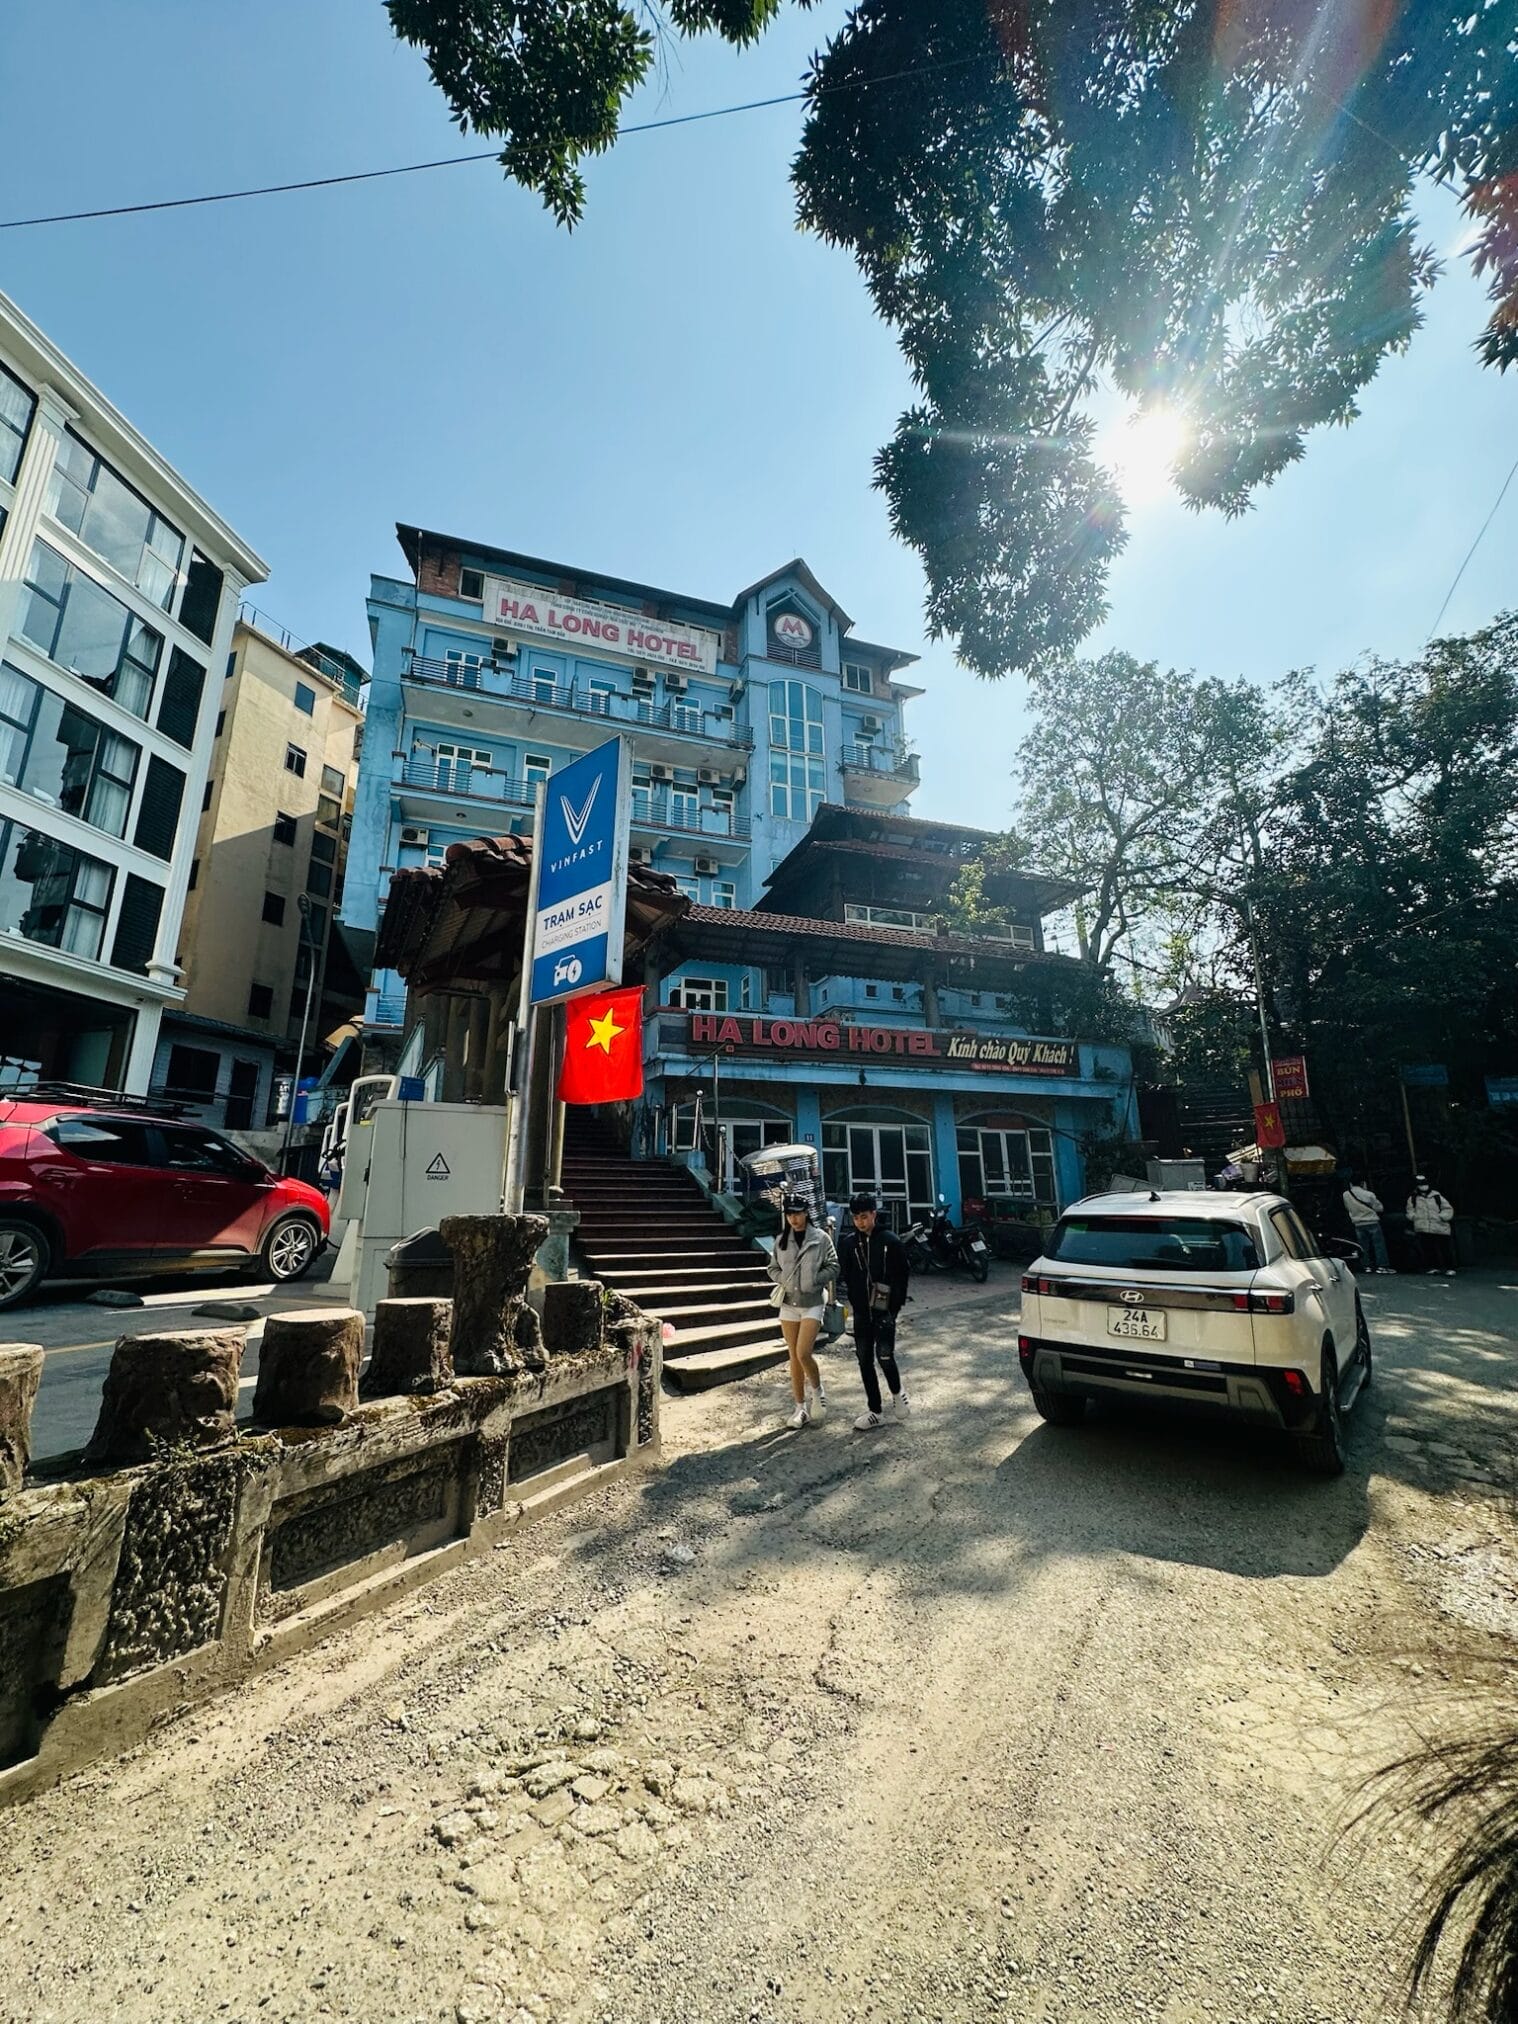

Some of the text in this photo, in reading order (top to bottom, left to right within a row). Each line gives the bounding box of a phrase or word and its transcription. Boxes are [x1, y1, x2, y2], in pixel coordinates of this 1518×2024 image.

[548, 609, 620, 641] LONG
[627, 628, 702, 662] HOTEL
[783, 617, 805, 636] M
[550, 840, 604, 873] VINFAST
[543, 895, 603, 930] TRẠM SẠC
[541, 919, 602, 949] CHARGING STATION
[692, 1015, 942, 1057] HẠ LONG HOTEL
[947, 1037, 978, 1058] Kính
[979, 1039, 1006, 1060] chào
[1007, 1041, 1032, 1065] Quý
[1032, 1043, 1067, 1064] Khách
[1123, 1310, 1148, 1323] 24A
